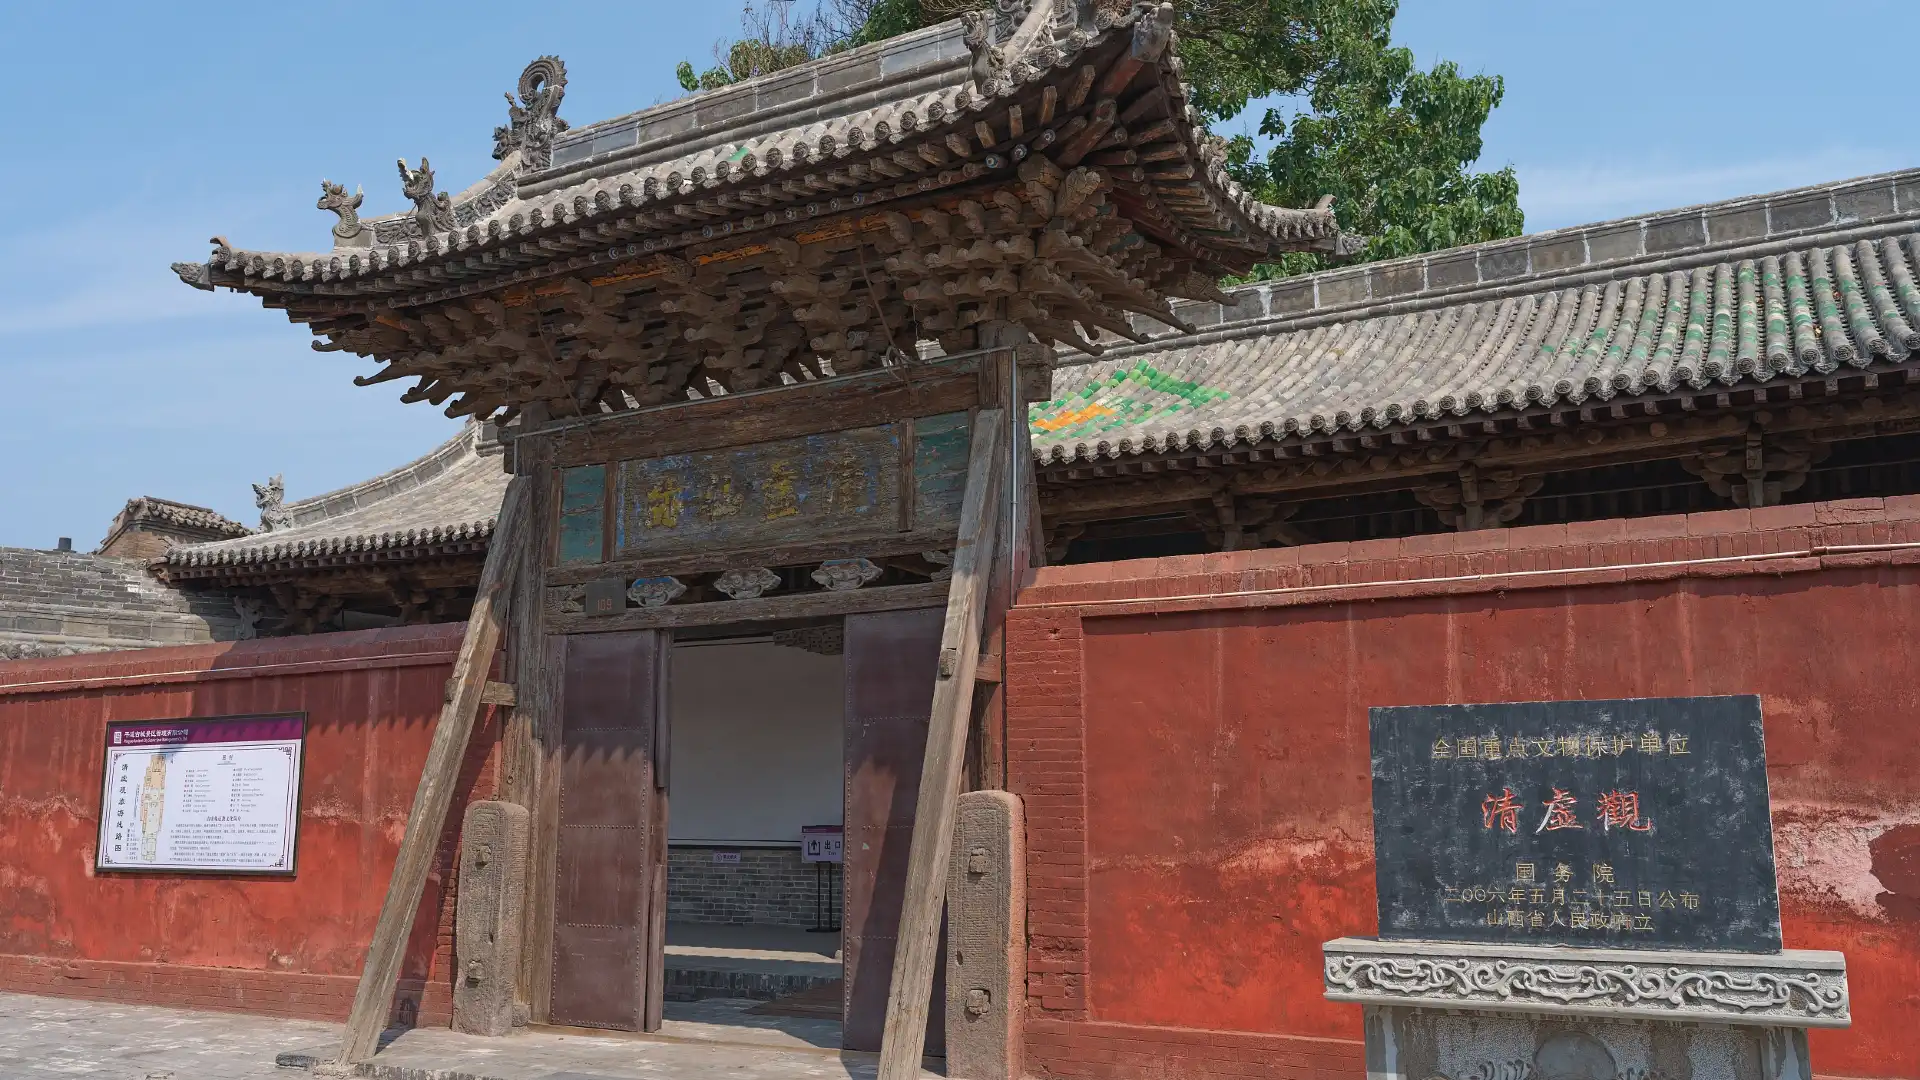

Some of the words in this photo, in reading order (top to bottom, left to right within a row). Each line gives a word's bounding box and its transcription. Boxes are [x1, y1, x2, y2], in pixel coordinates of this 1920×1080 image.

[1431, 734, 1691, 759] 全国重点文物保护单位
[824, 840, 841, 850] 出口
[1515, 862, 1615, 883] 国务院
[1486, 908, 1654, 931] 山西省人民政府立
